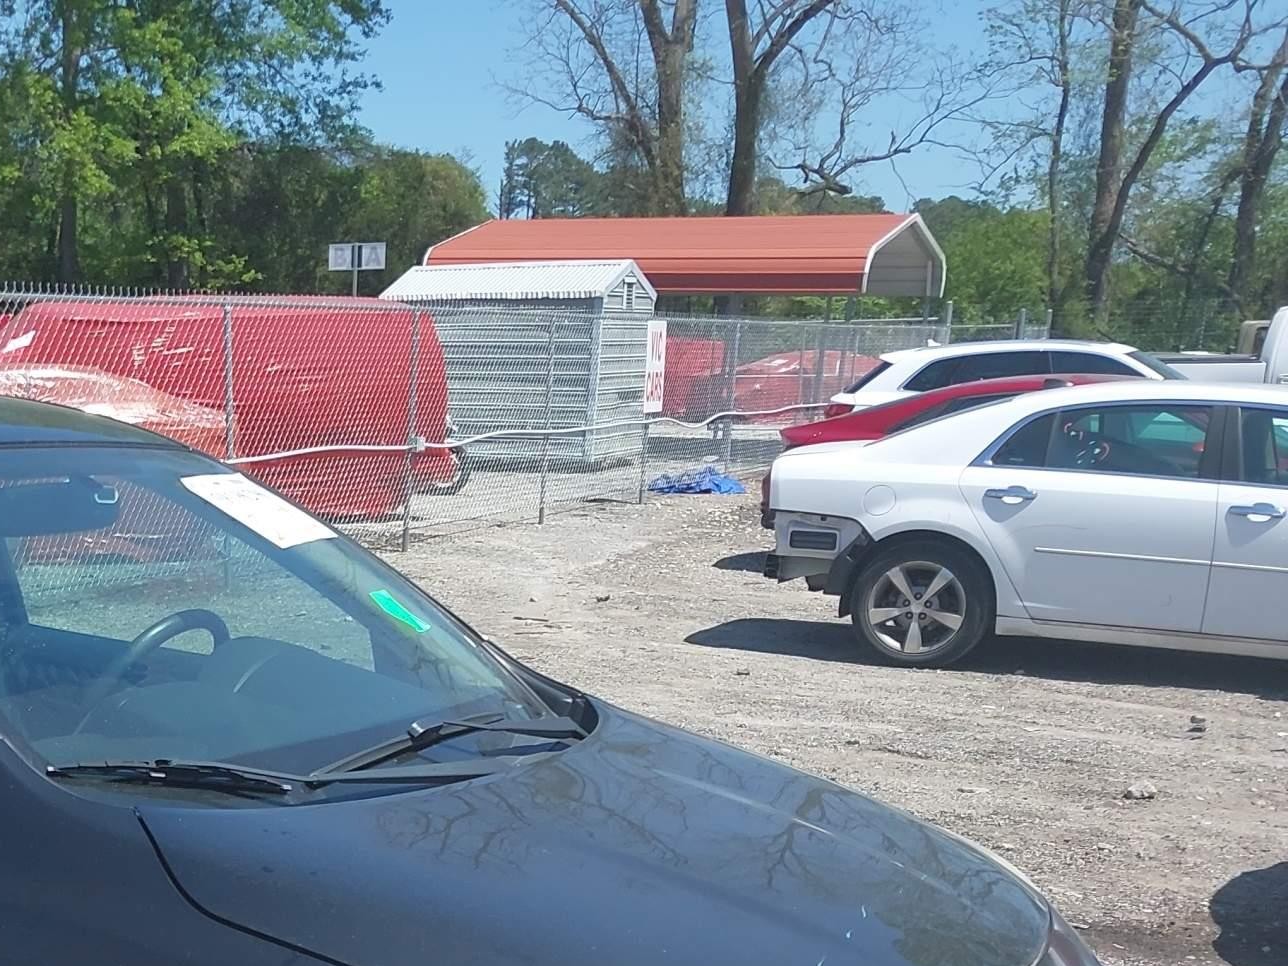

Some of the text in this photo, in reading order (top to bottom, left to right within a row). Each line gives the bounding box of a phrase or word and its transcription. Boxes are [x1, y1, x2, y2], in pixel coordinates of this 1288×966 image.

[365, 246, 383, 267] A
[651, 330, 663, 361] VIC
[646, 371, 662, 402] CARS
